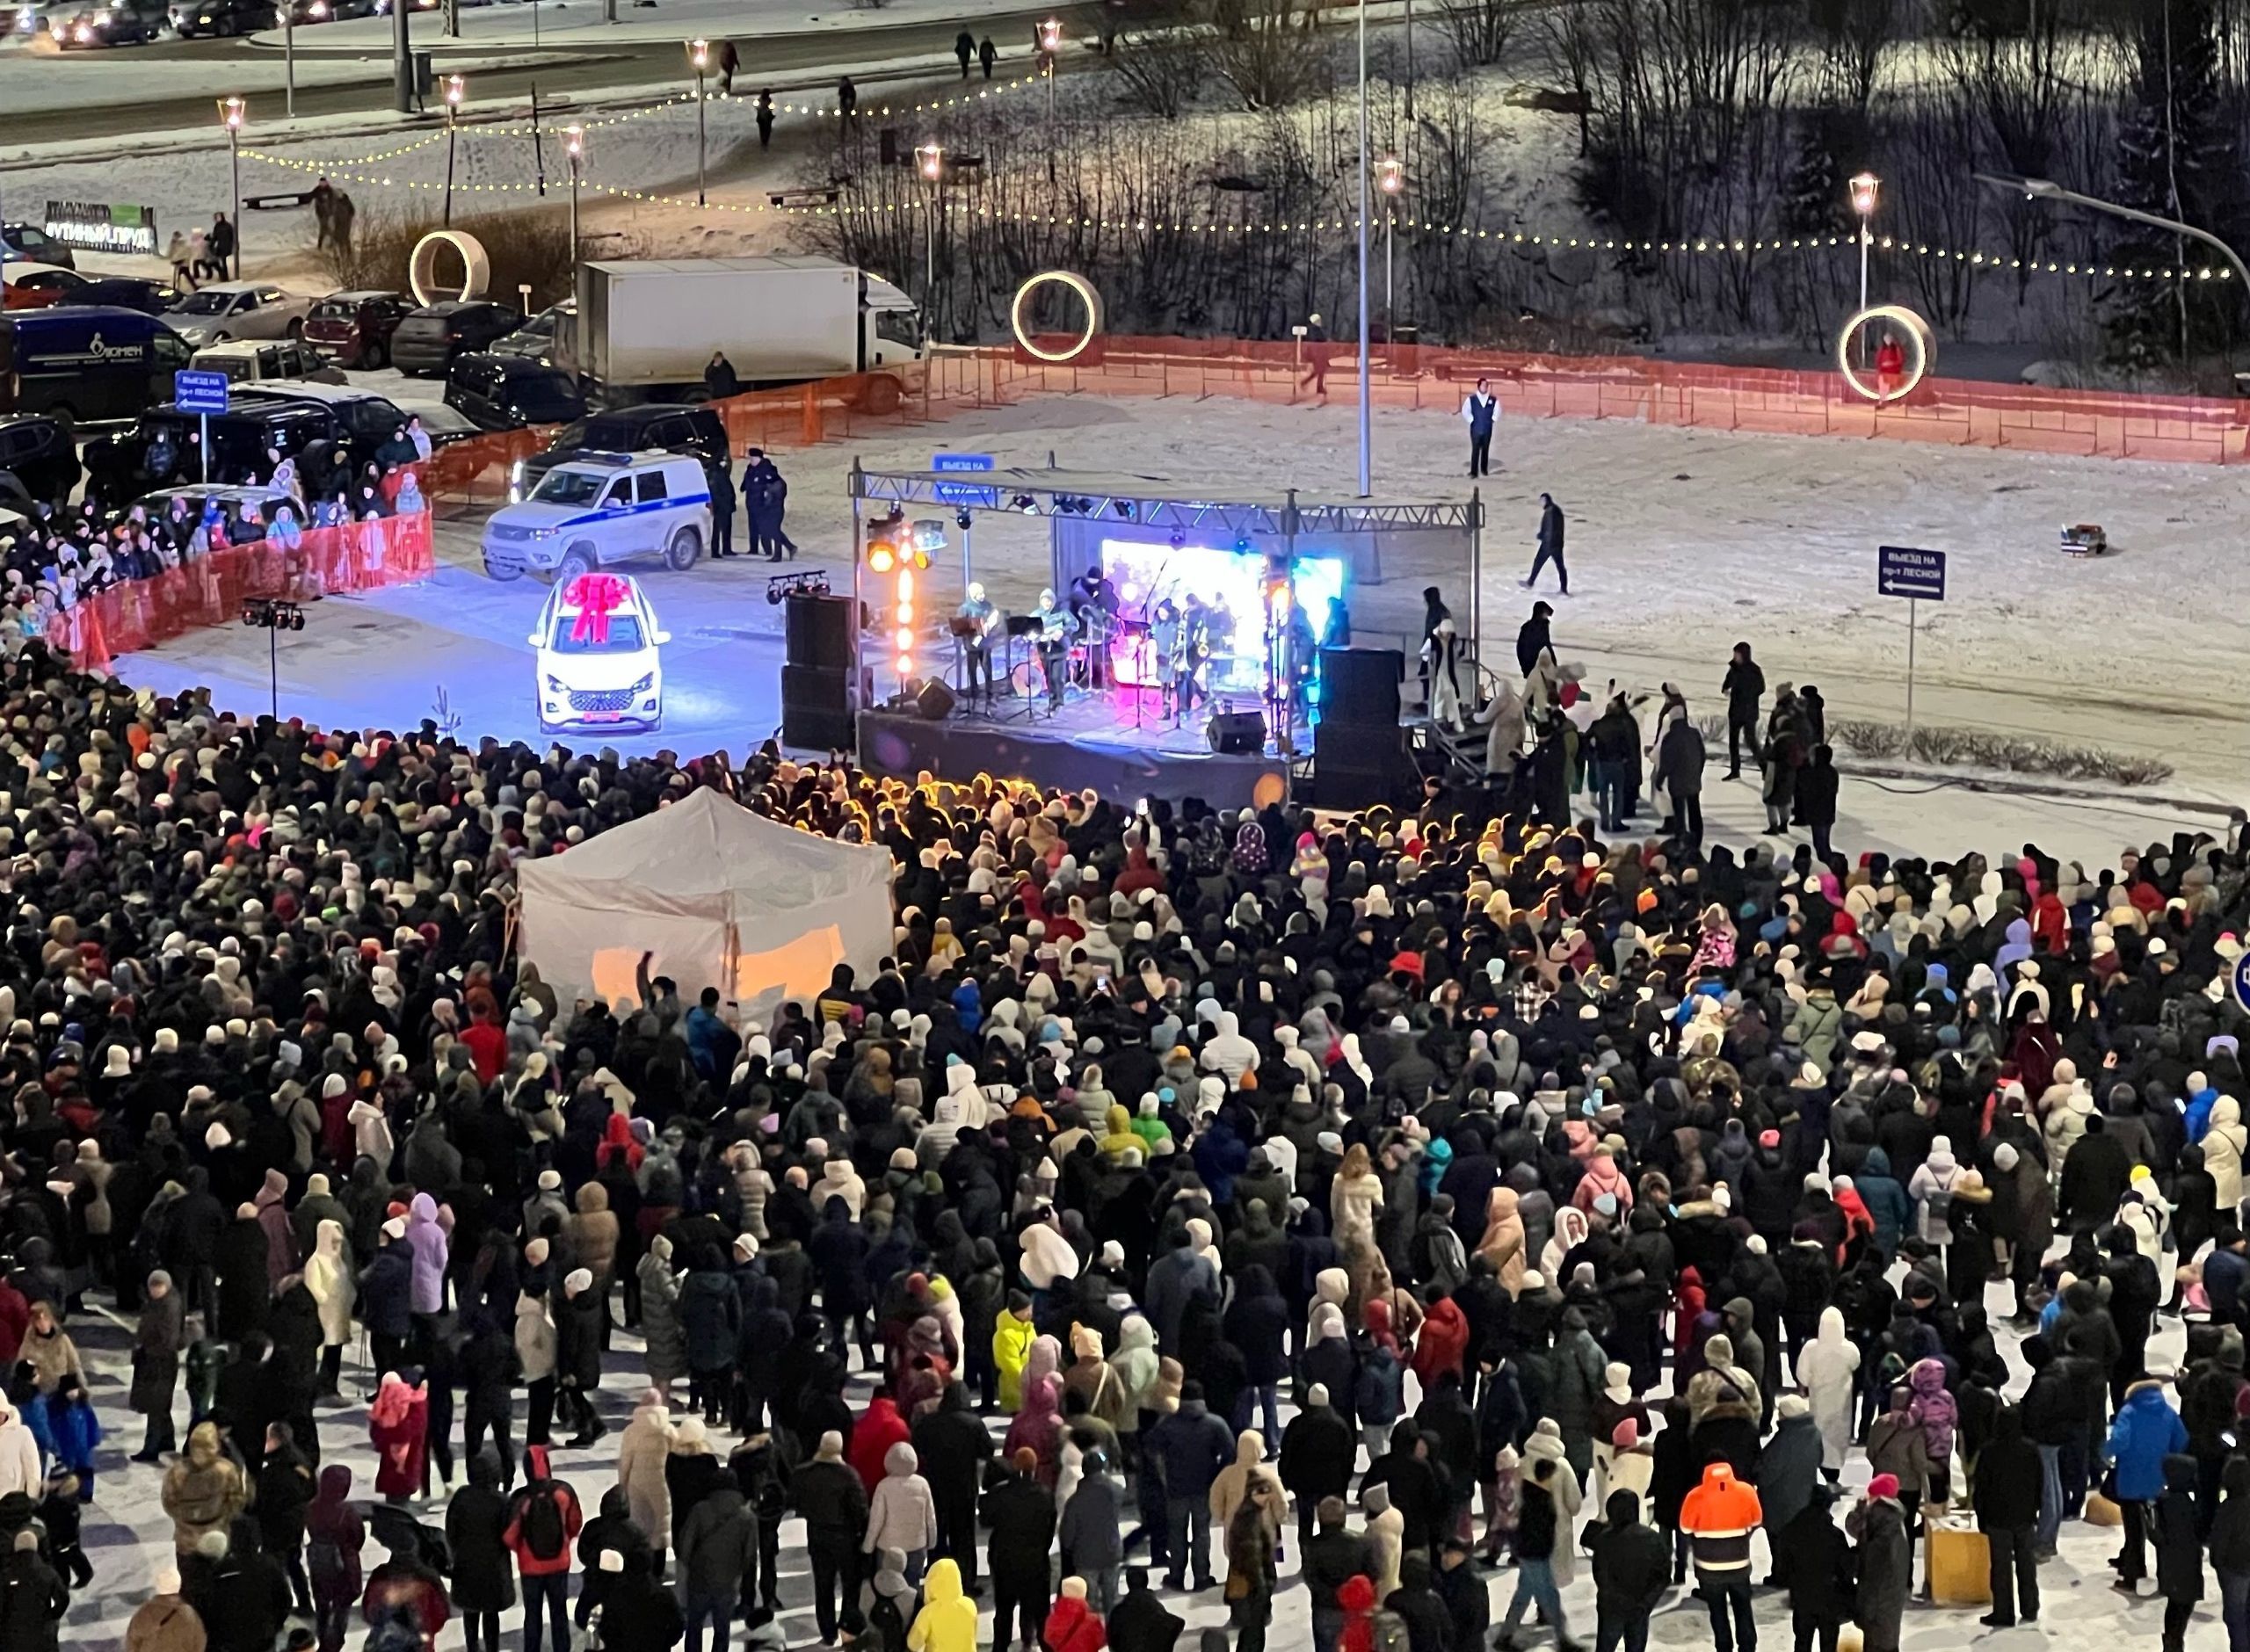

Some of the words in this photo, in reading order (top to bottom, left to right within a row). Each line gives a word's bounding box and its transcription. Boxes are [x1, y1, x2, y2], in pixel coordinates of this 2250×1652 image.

[112, 226, 151, 249] ПРУД
[972, 462, 985, 471] НА
[1888, 552, 1922, 565] ВЫЕЗД
[1923, 555, 1937, 566] НА
[1903, 567, 1942, 579] ЛЕСНОЙ
